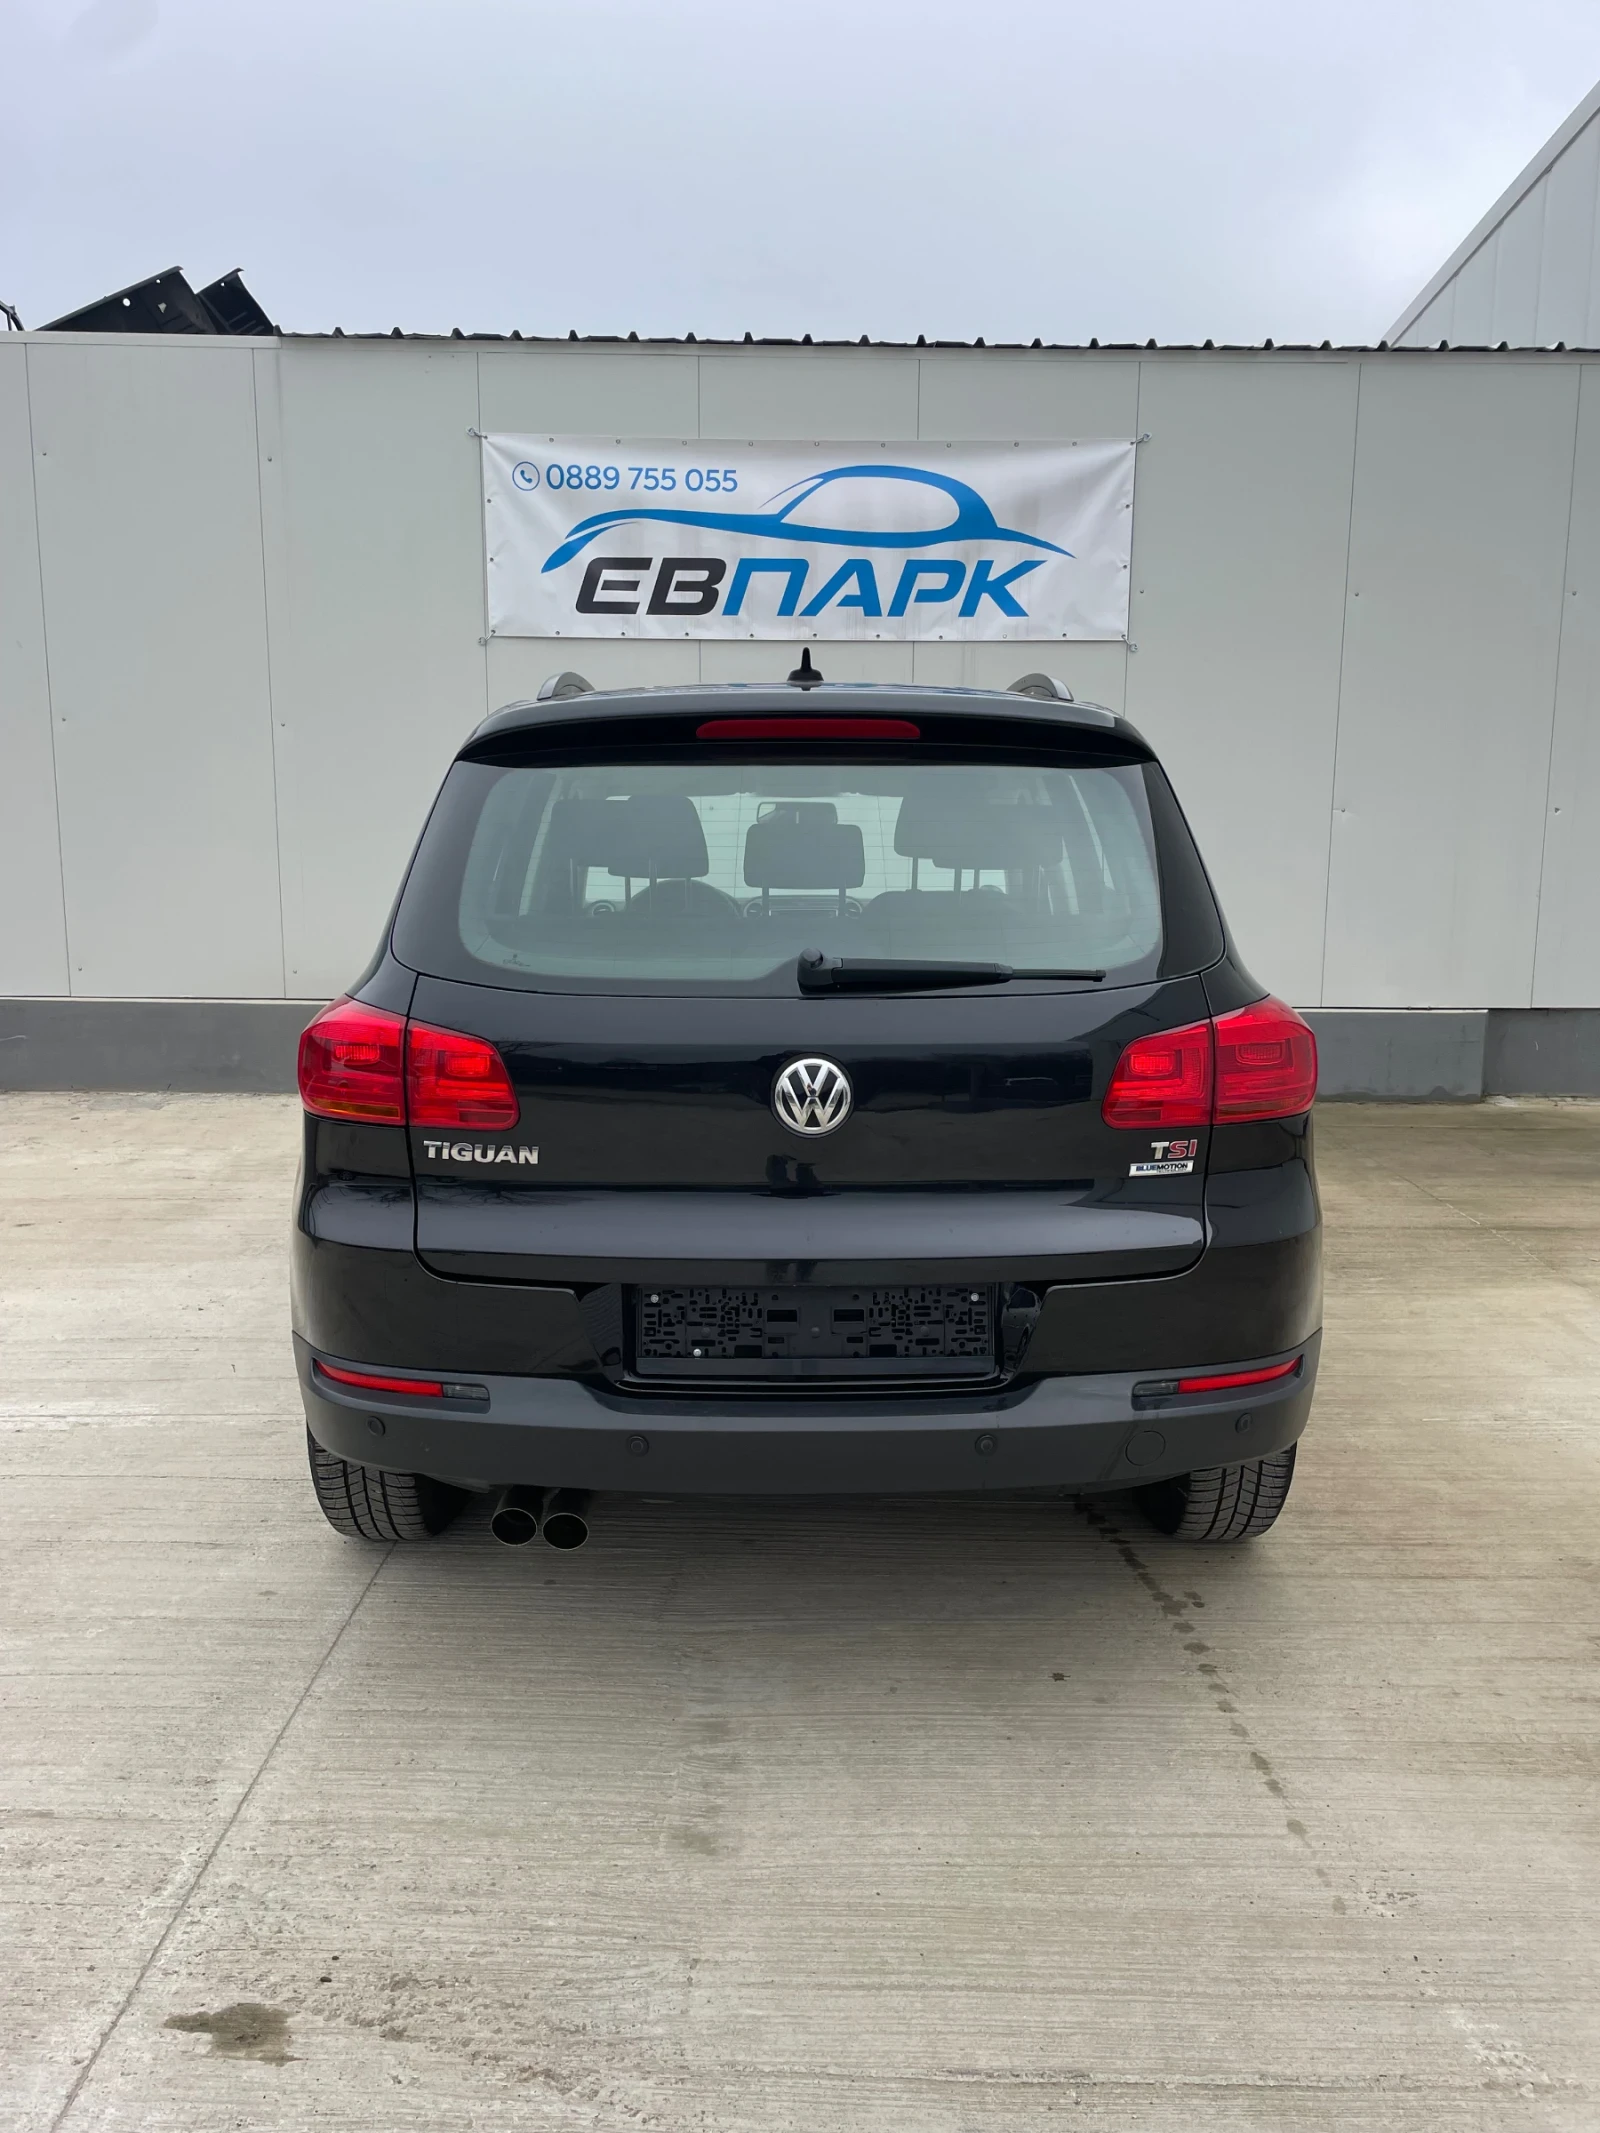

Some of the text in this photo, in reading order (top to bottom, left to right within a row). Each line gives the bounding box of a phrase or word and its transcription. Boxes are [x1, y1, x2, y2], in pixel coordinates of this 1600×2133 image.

[546, 464, 738, 492] 0889 755 055
[575, 557, 1048, 617] ЕВПАРК
[423, 1140, 539, 1164] TIGUAN
[1150, 1139, 1198, 1160] TSI
[1136, 1162, 1188, 1171] BLUEMOTION
